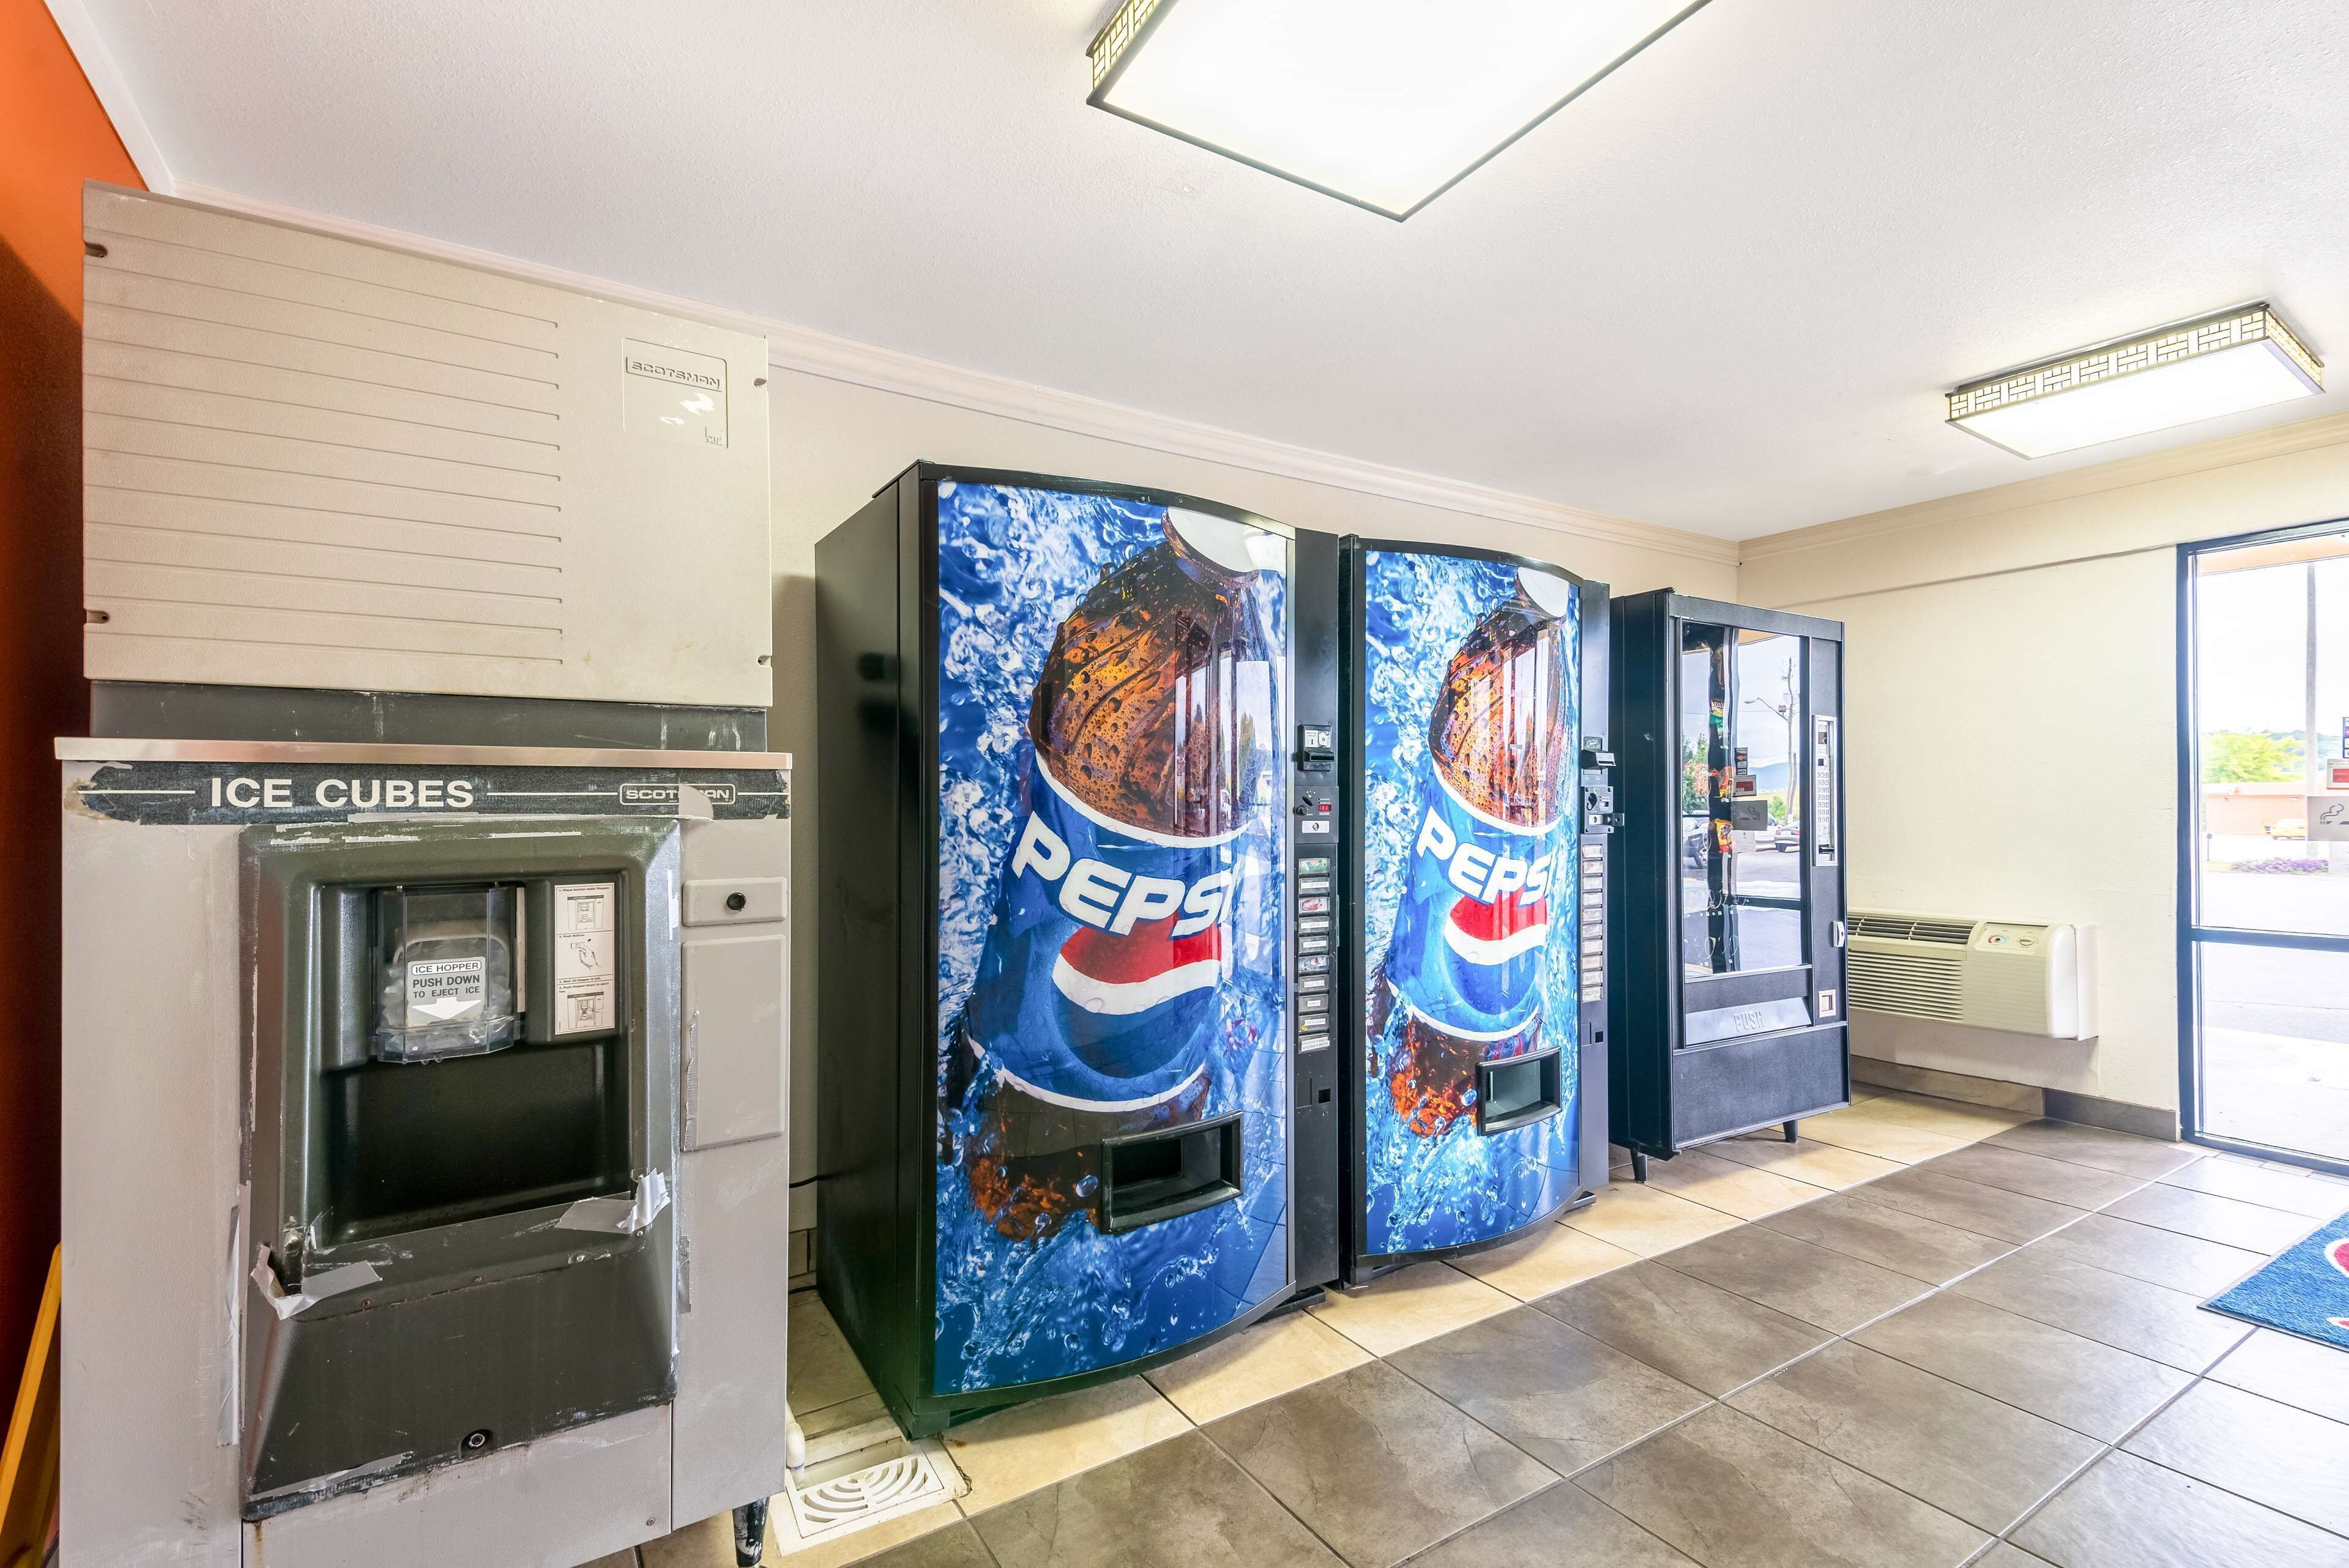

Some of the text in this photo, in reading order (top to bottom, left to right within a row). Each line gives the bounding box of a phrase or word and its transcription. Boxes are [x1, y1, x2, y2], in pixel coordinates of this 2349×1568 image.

[631, 361, 720, 388] SCOTSMAN
[211, 777, 474, 808] ICE CUBES
[625, 789, 729, 800] SCOTAN
[415, 962, 478, 973] ICE HOPPER
[412, 975, 480, 988] PUSH DOWN
[431, 987, 459, 997] EJECT
[1733, 1009, 1765, 1032] PUSH
